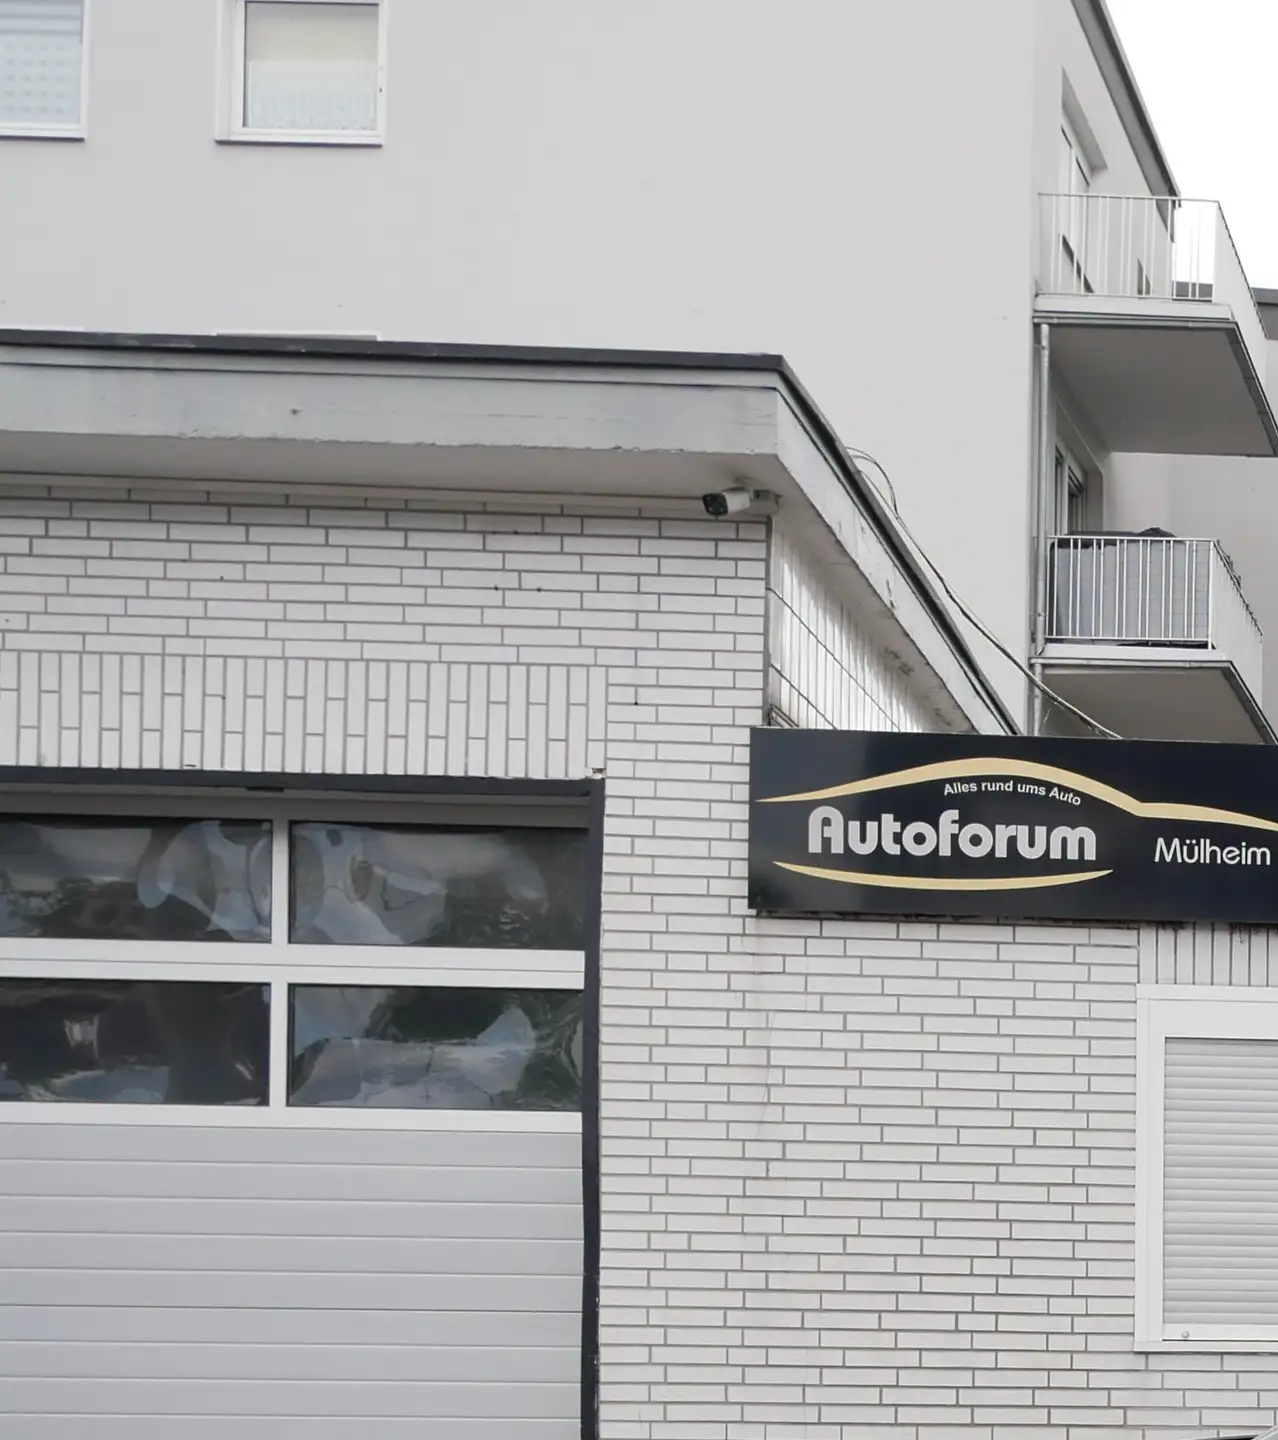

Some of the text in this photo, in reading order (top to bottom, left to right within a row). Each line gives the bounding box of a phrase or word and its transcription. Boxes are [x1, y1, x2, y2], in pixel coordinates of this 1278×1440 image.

[943, 779, 1082, 806] Alles rund ums Auto
[807, 805, 1097, 861] Autoforum
[1154, 836, 1271, 866] Mülheim
